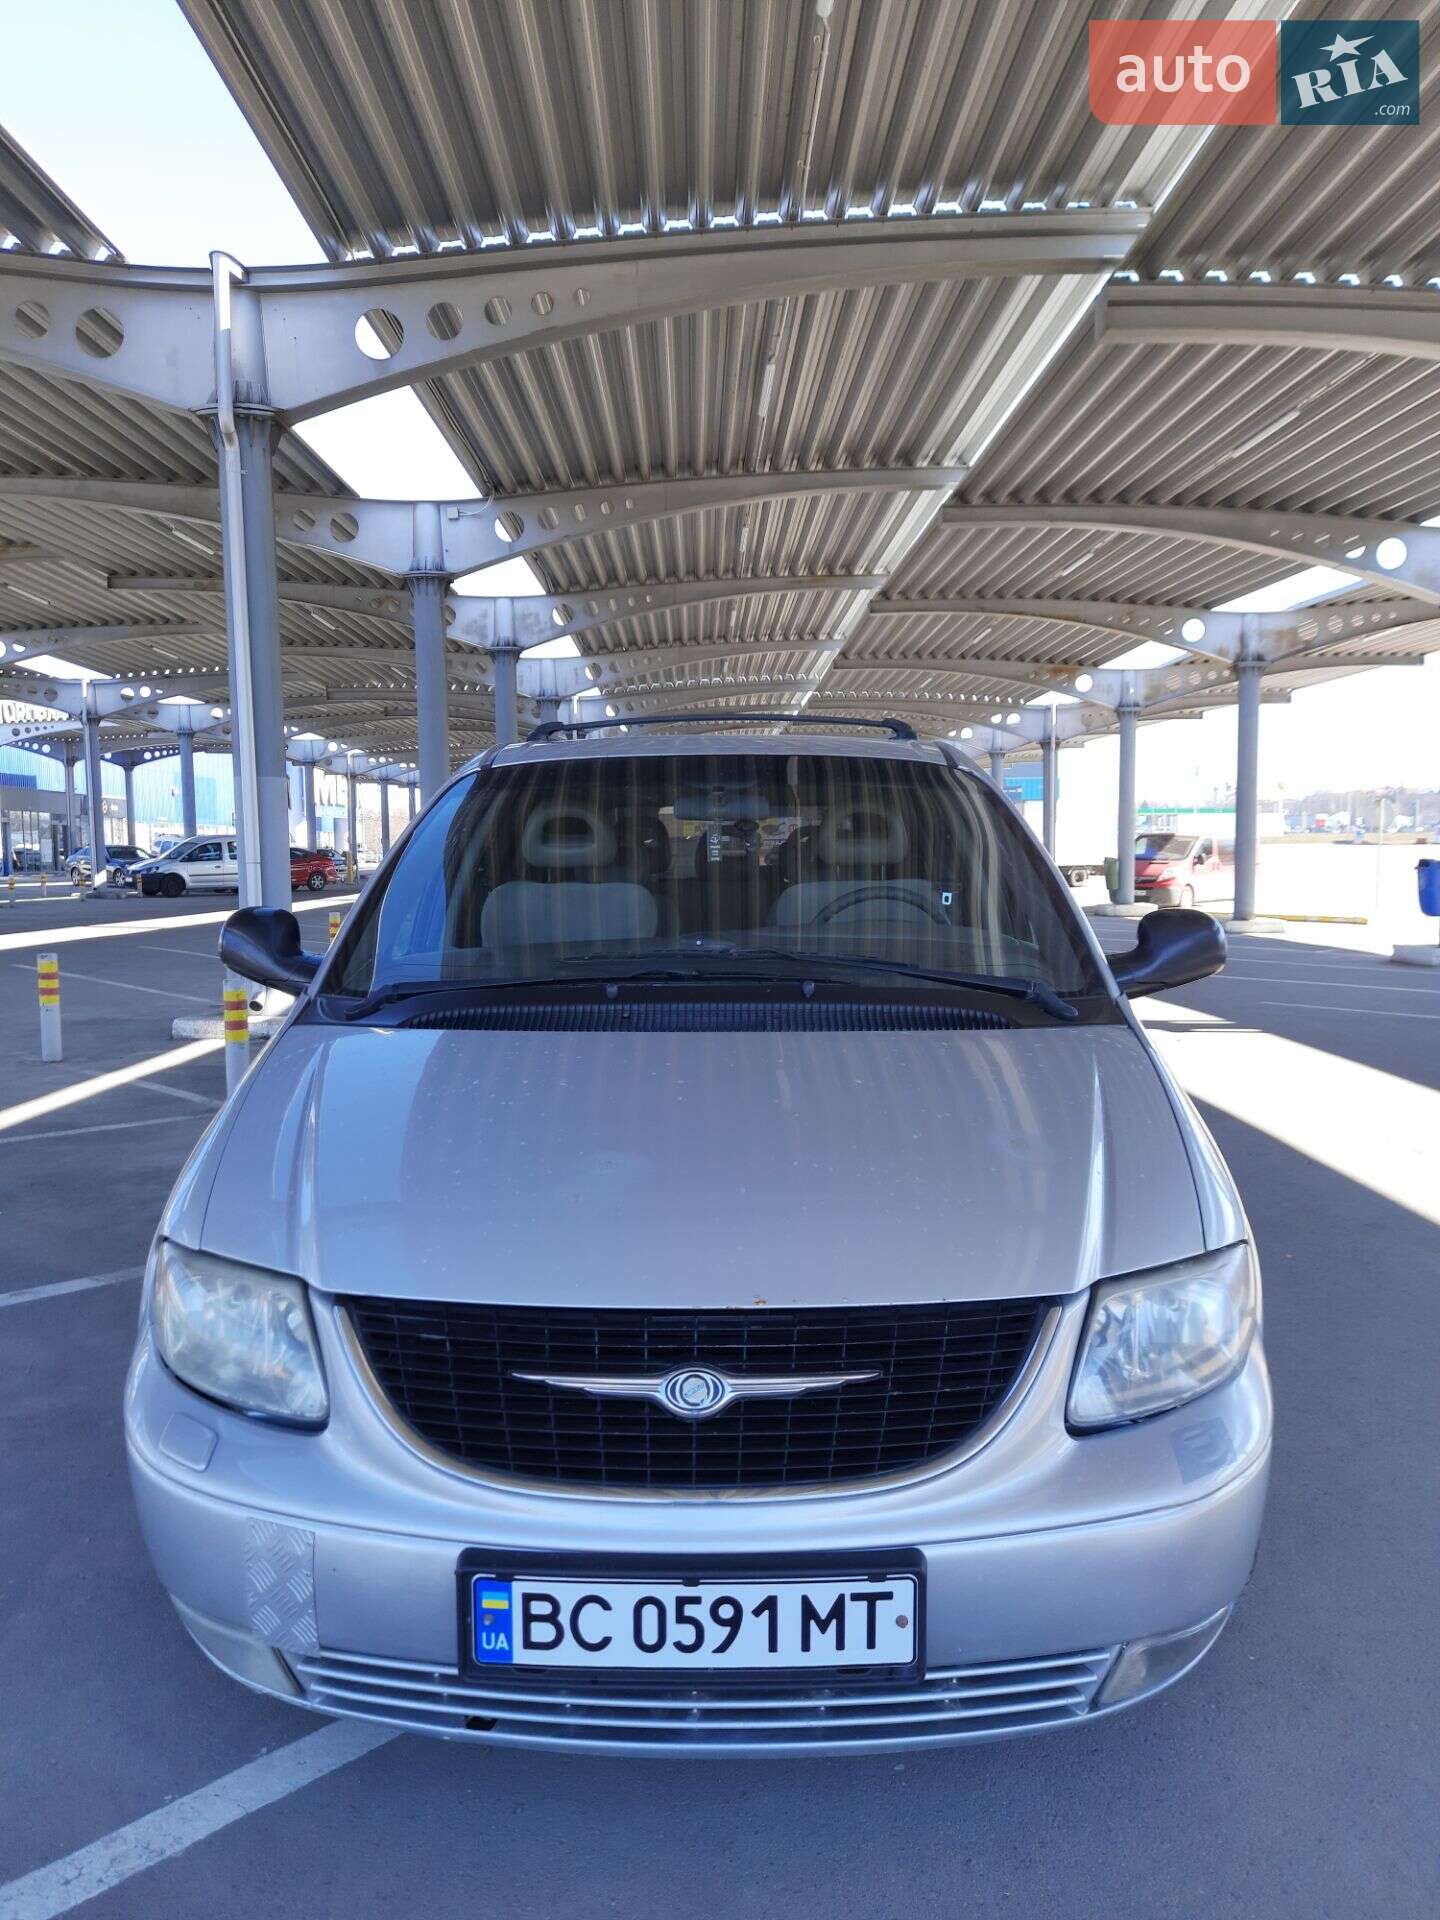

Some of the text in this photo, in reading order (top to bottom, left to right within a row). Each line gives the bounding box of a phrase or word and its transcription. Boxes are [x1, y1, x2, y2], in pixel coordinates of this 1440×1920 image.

[482, 1632, 509, 1651] UA
[521, 1591, 894, 1654] BC 0591 MT
